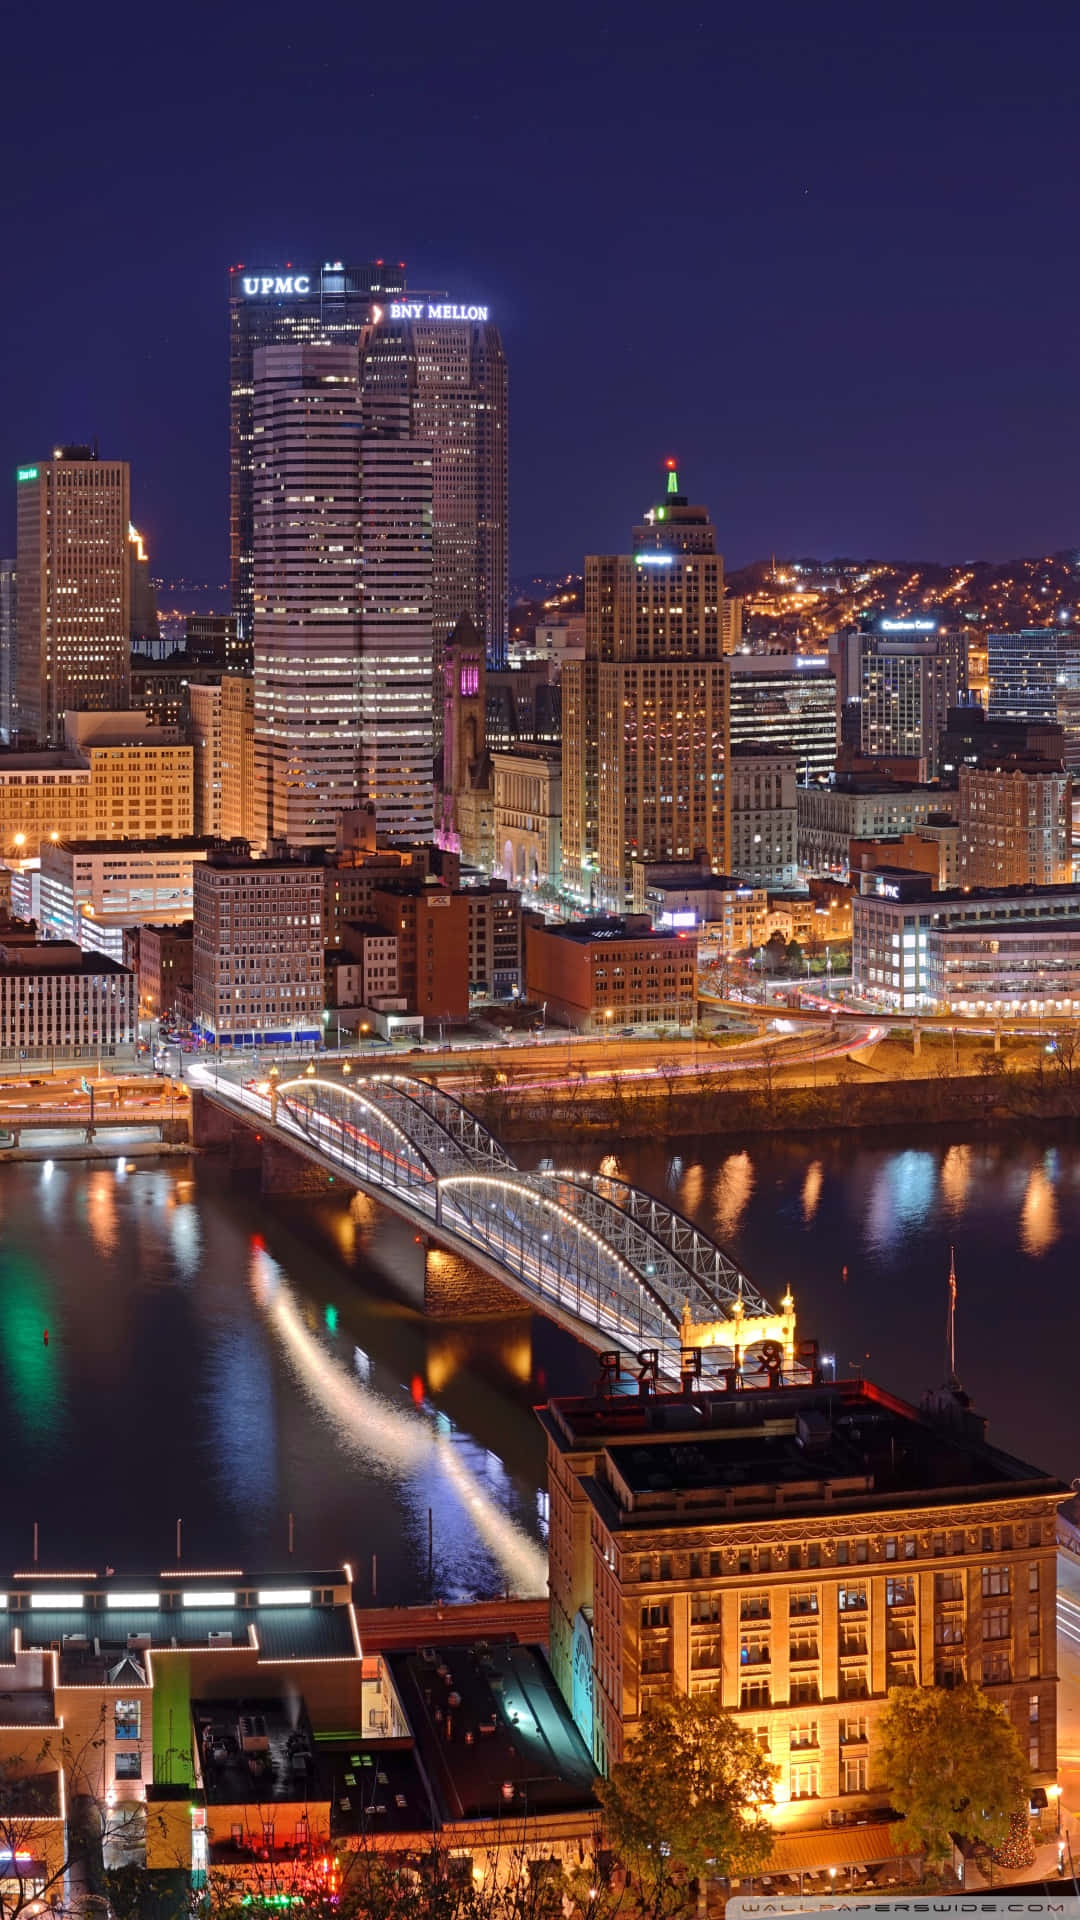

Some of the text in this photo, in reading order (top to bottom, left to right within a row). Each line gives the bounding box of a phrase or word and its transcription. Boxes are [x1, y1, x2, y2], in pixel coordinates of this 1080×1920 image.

[243, 276, 310, 295] UPMC
[391, 303, 488, 320] BNY MELLON
